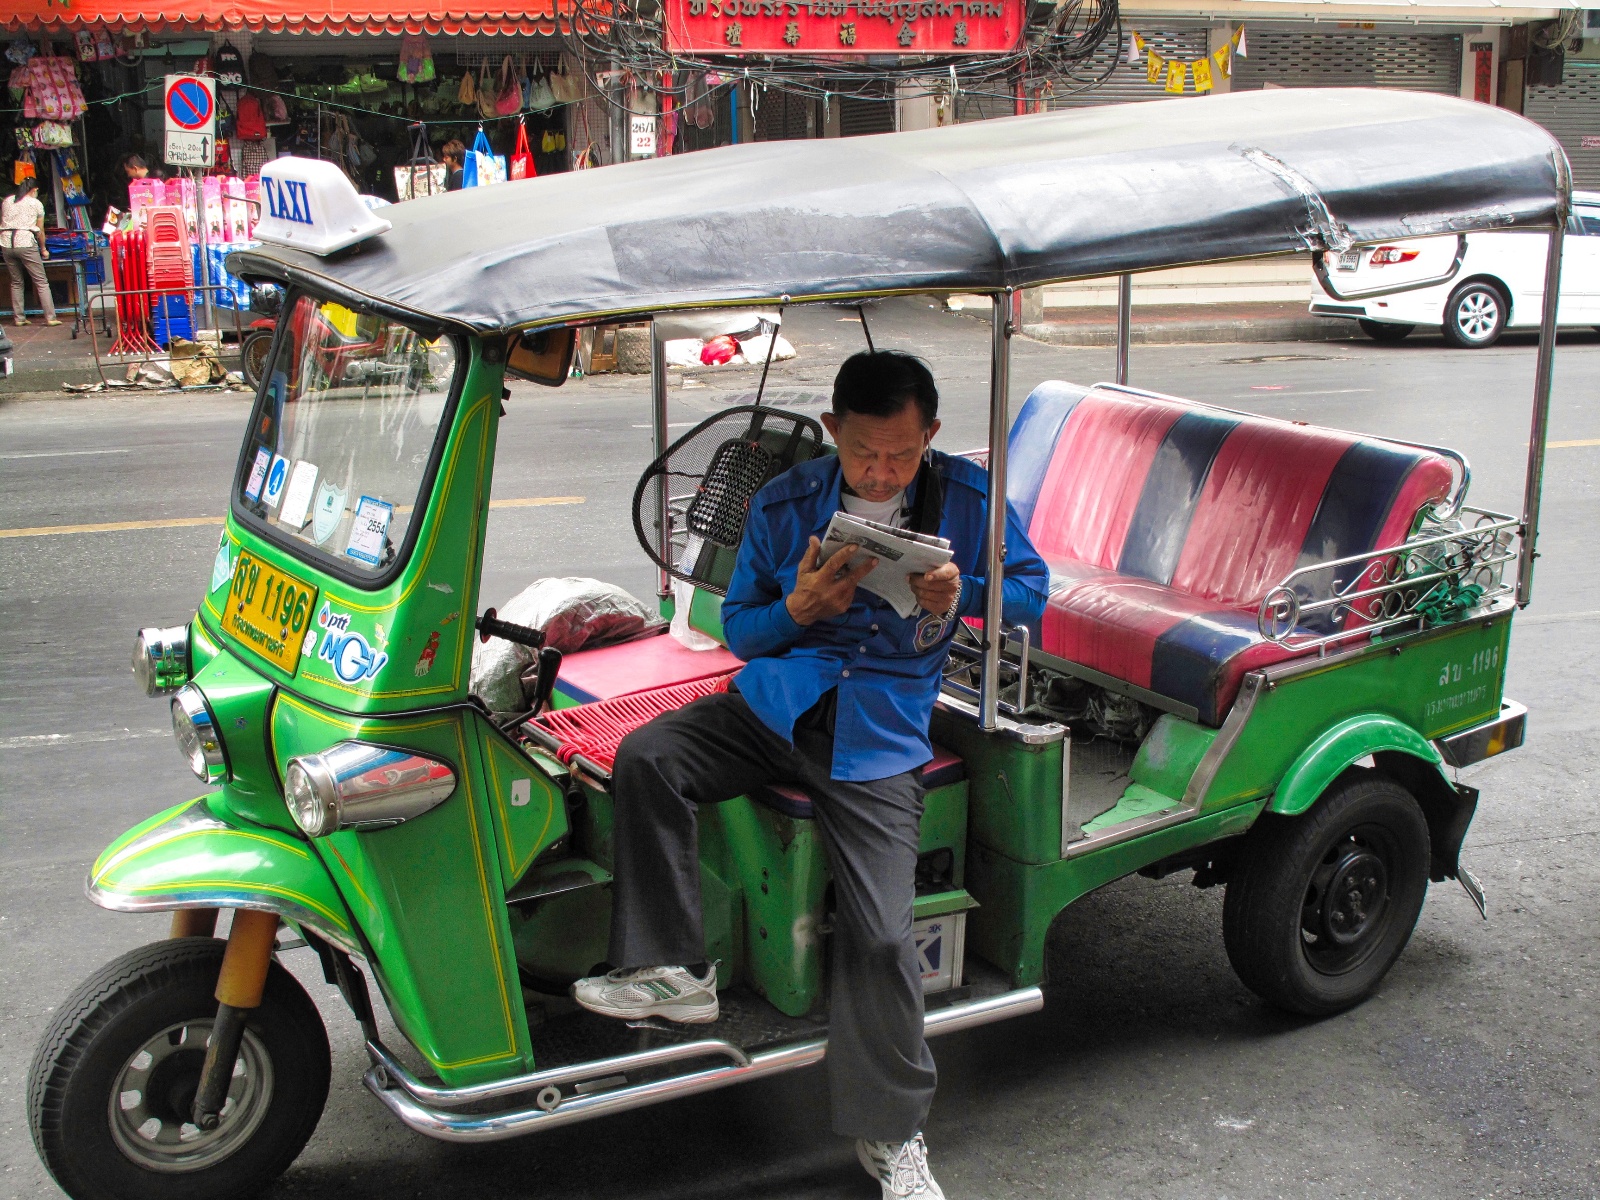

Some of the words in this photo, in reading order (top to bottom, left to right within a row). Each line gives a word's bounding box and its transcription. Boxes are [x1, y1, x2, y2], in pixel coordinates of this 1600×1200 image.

[632, 122, 655, 133] 26/1
[637, 136, 651, 147] 22
[261, 176, 314, 225] TAXI
[367, 519, 386, 536] 2554
[261, 573, 309, 633] 1196
[327, 612, 349, 631] ptt
[320, 632, 387, 682] NGV
